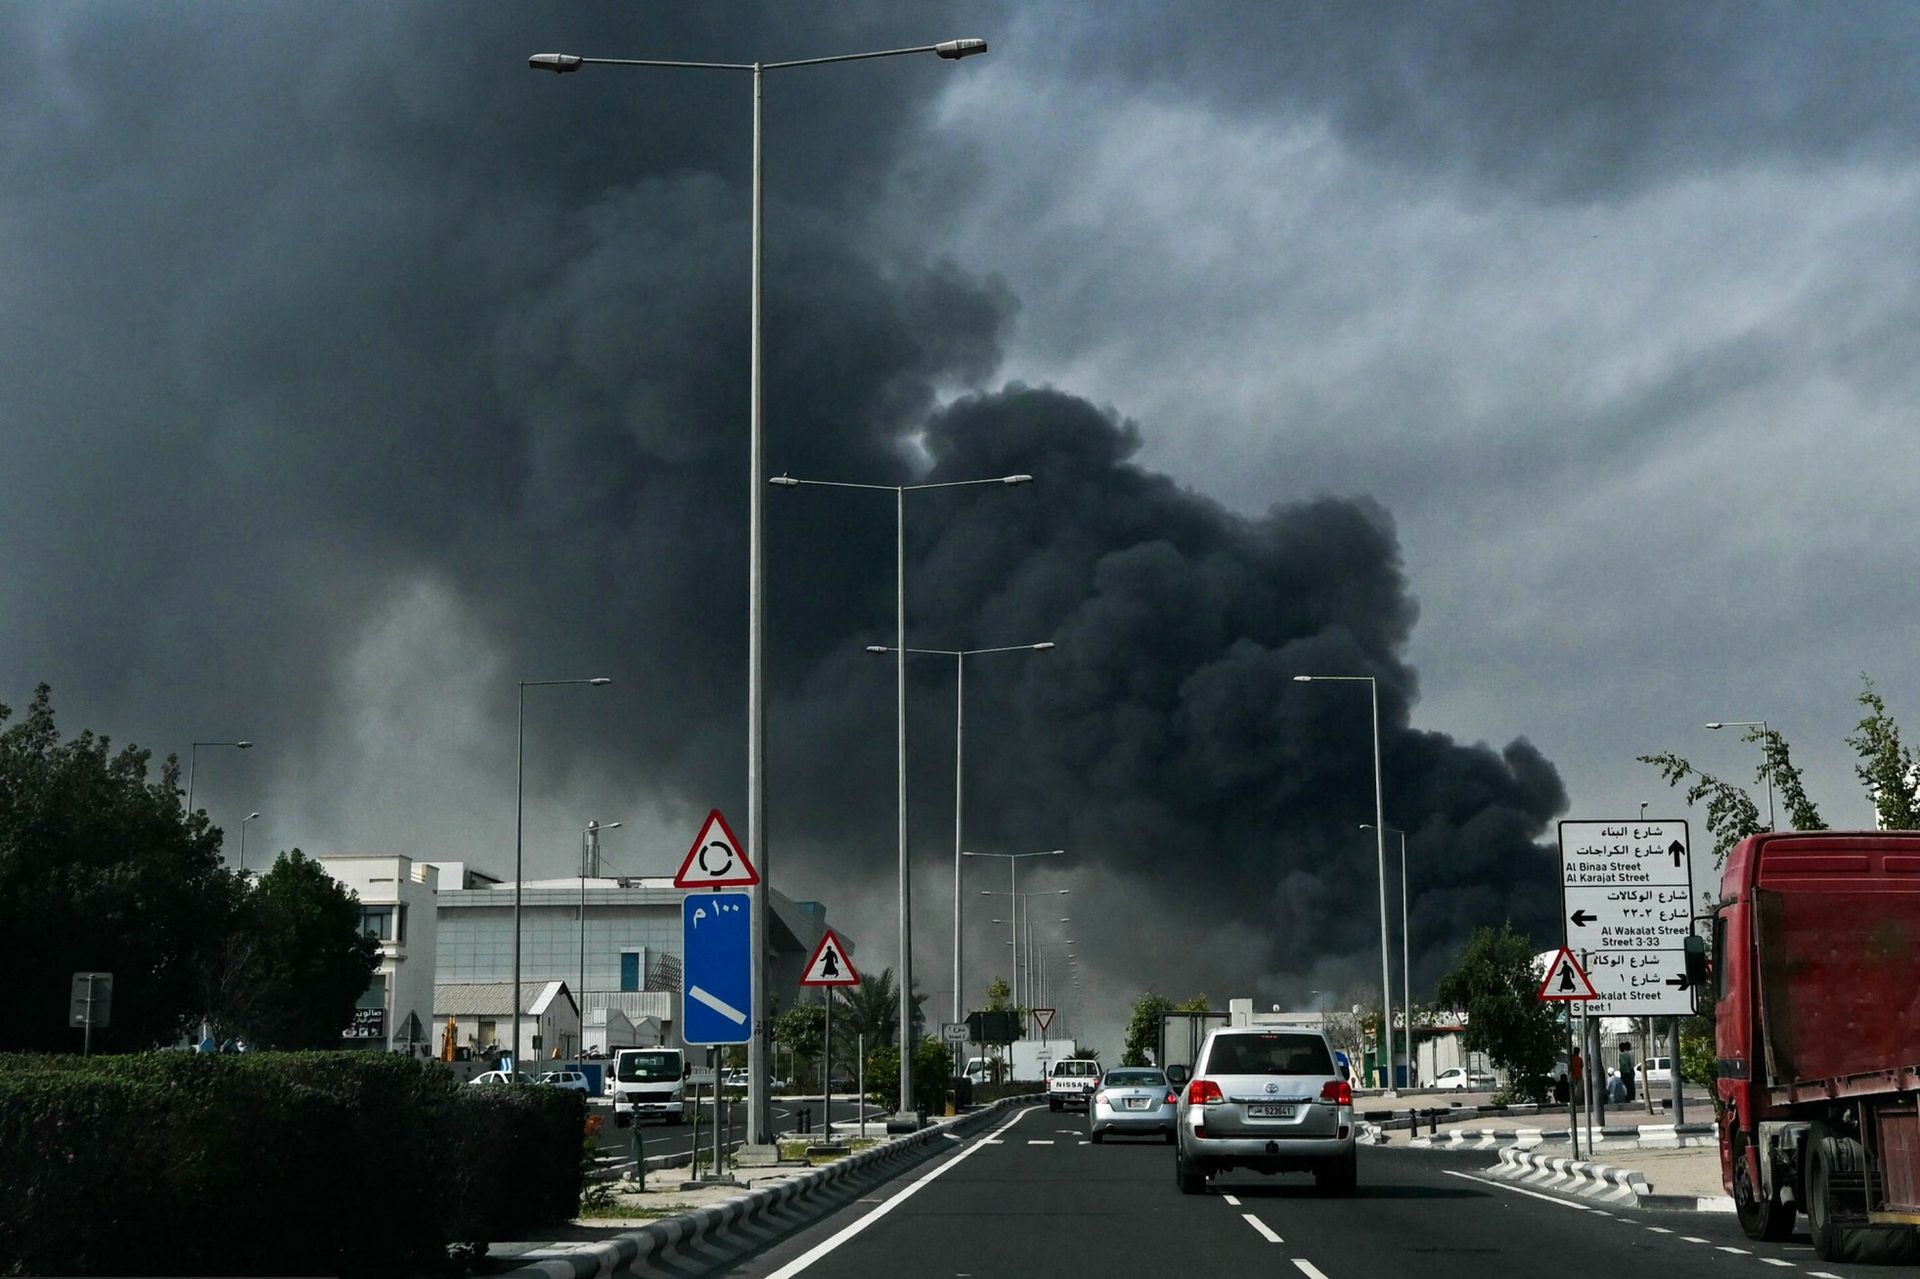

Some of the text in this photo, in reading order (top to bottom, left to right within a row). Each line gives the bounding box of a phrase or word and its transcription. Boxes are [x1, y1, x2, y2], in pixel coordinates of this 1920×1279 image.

[1601, 826, 1663, 839] شارع البناء
[1576, 845, 1664, 858] شارع الكراجات
[1566, 862, 1641, 871] Al Binaa Street
[1566, 873, 1650, 883] Al Karajat Street
[1607, 890, 1688, 903] شارع الوكالات
[693, 908, 706, 930] م
[1659, 908, 1689, 921] شارع
[1601, 925, 1689, 935] Al Wakalat Street
[1602, 937, 1660, 947] Street 3-33
[1630, 954, 1660, 967] شارع
[1620, 973, 1661, 986] شارع ١
[1596, 991, 1661, 1000] akalat Street
[1573, 1003, 1612, 1012] Sreet 1
